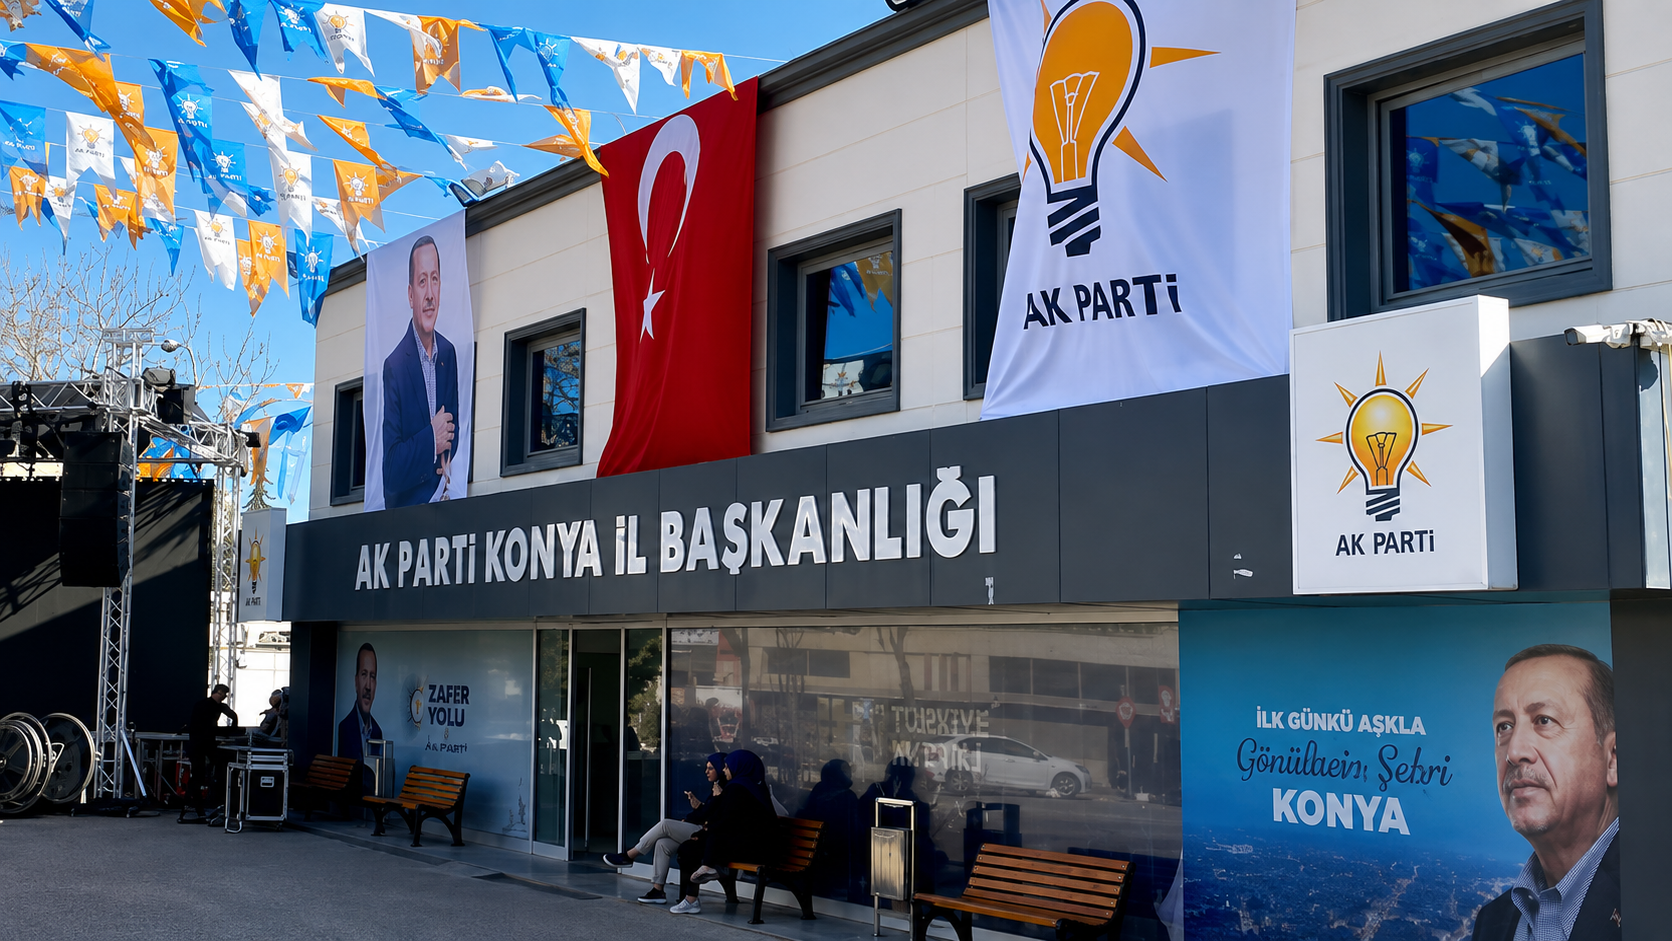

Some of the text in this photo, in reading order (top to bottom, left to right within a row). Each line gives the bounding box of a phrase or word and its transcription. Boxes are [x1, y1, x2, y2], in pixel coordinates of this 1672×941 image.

[1023, 287, 1073, 330] AK
[354, 542, 391, 591] AK
[484, 519, 604, 583] KONYA
[659, 465, 996, 576] BAŞKANLIĞI
[1335, 532, 1366, 557] AK
[428, 684, 470, 705] ZAFER
[428, 706, 465, 728] YOLU
[1256, 706, 1427, 738] İLK GÜNKÜ AŞKLA
[1272, 787, 1411, 836] KONYA
